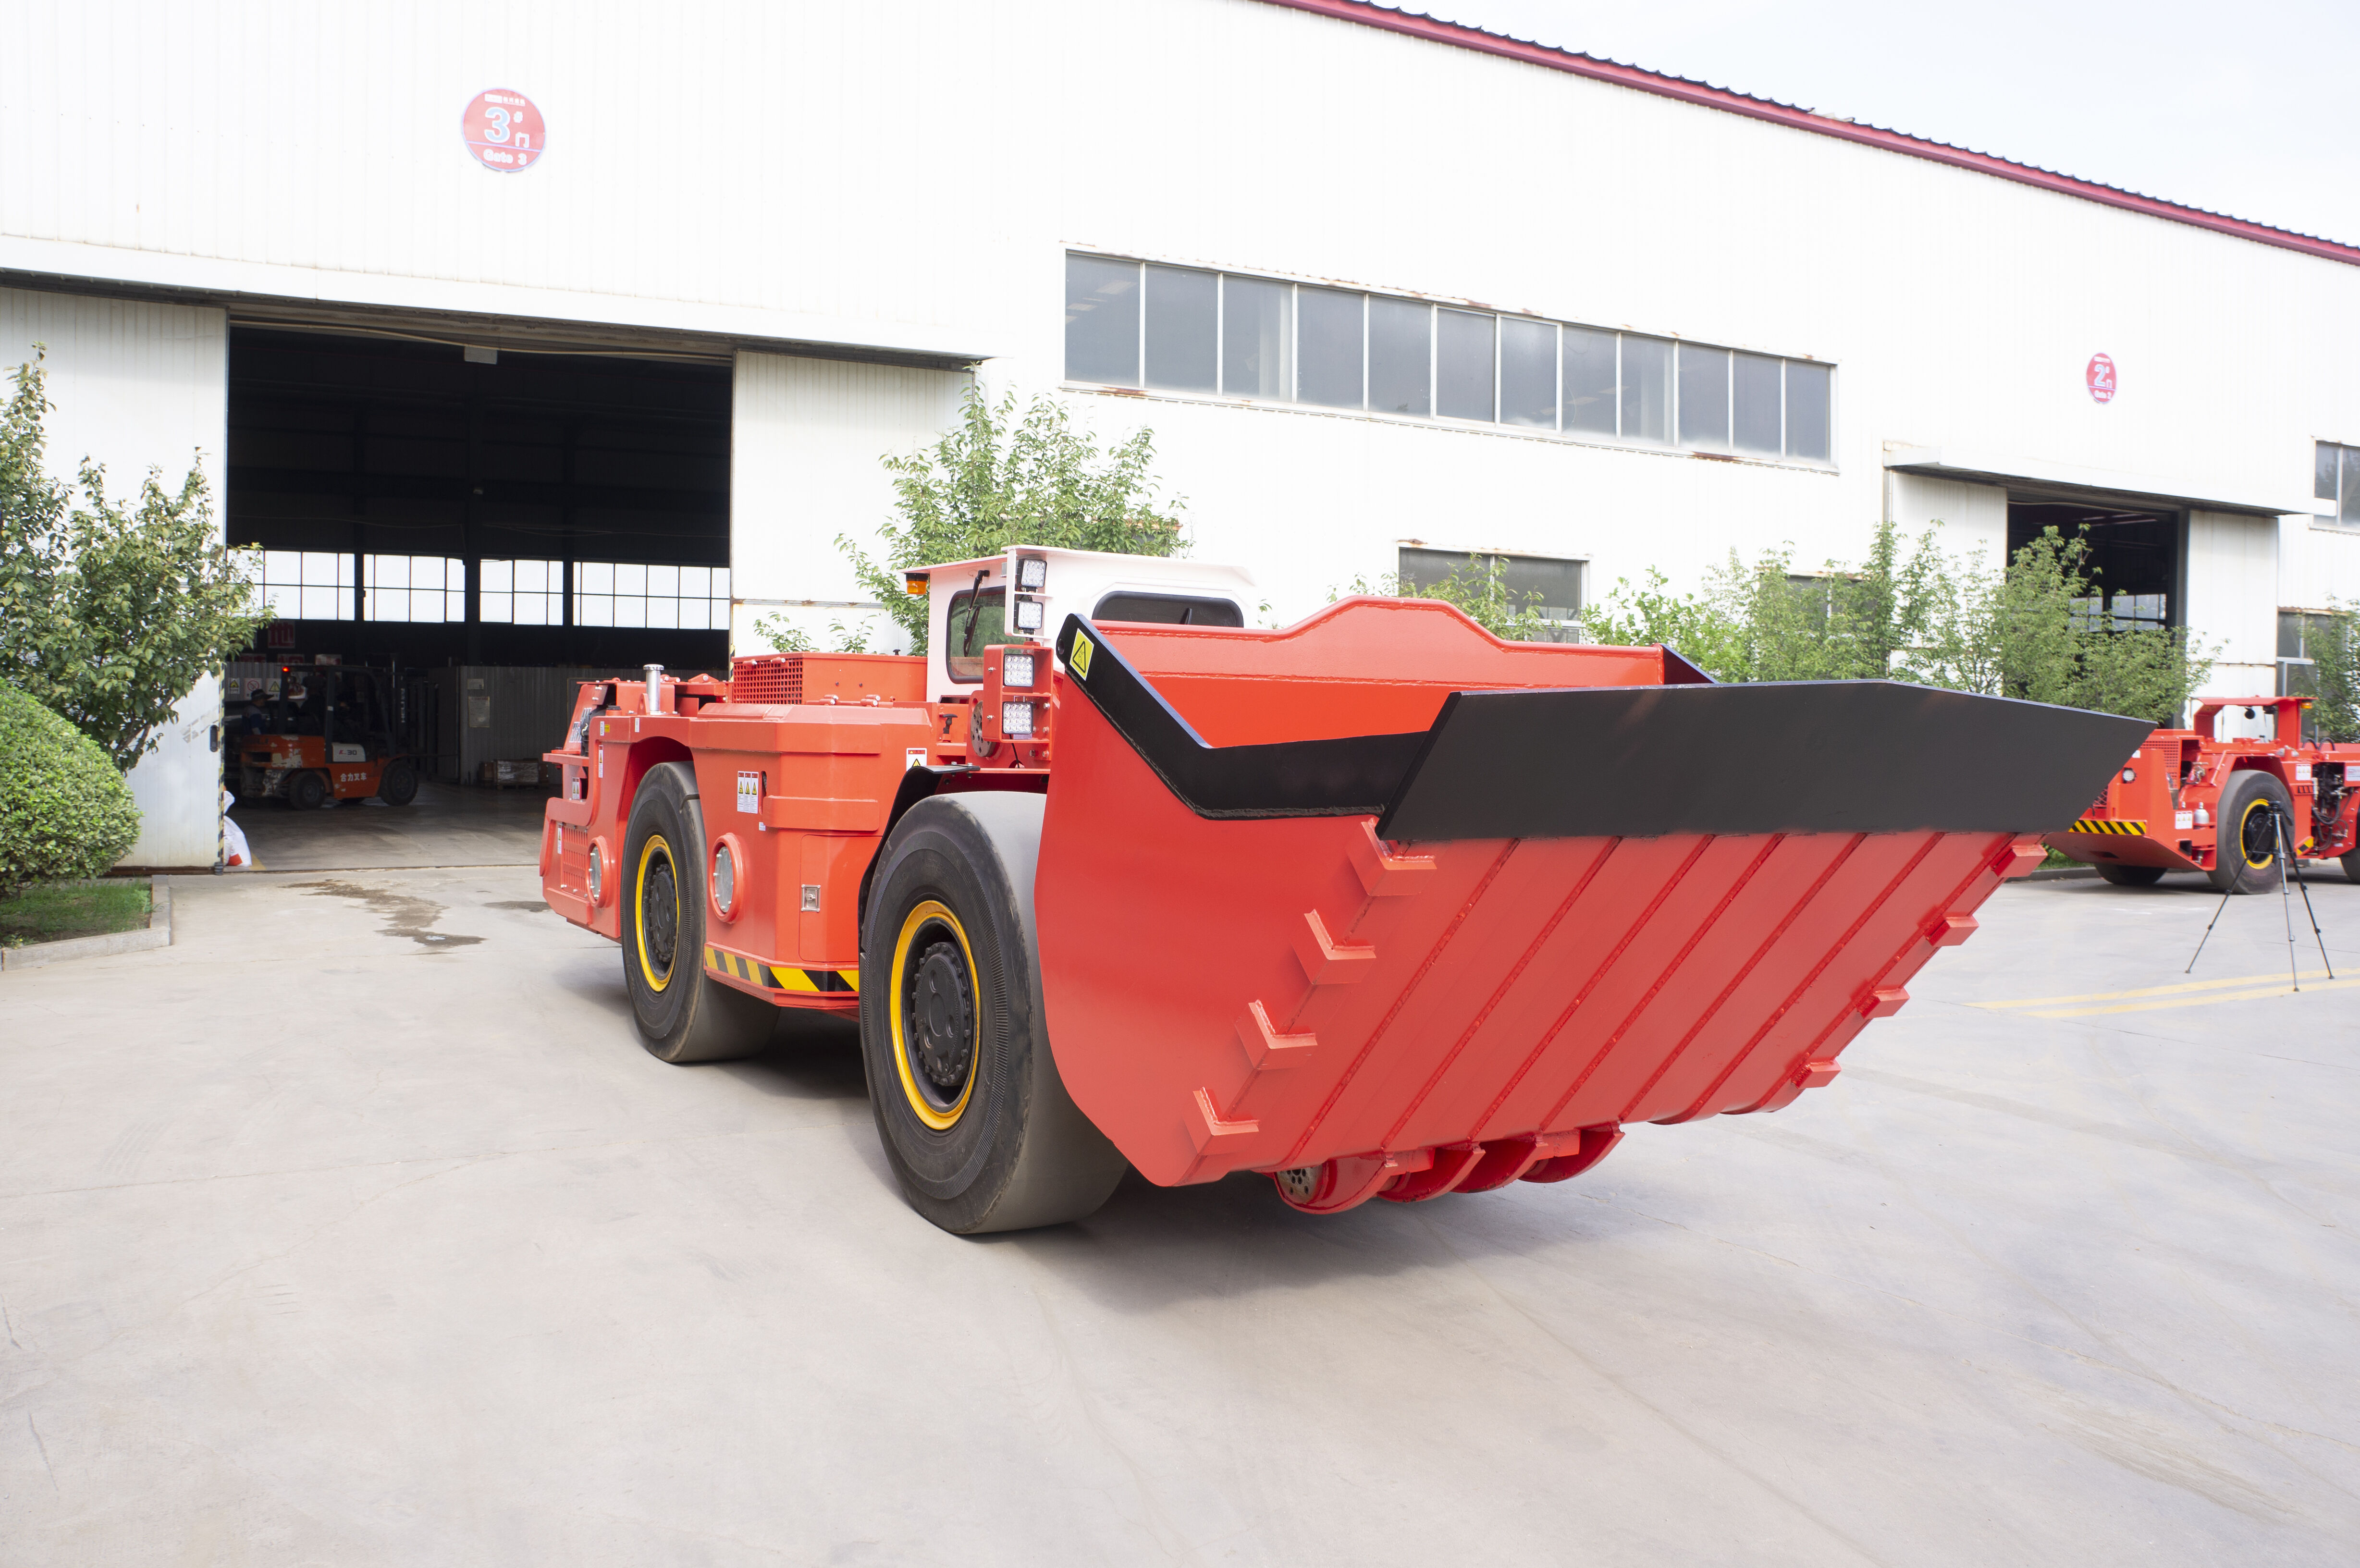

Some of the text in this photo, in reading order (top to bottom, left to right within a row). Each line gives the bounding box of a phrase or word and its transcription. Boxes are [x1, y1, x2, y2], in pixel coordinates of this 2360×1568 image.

[485, 107, 510, 143] 3
[484, 149, 527, 165] Gate 3
[2095, 364, 2105, 386] 2
[341, 772, 367, 782] 合力叉车
